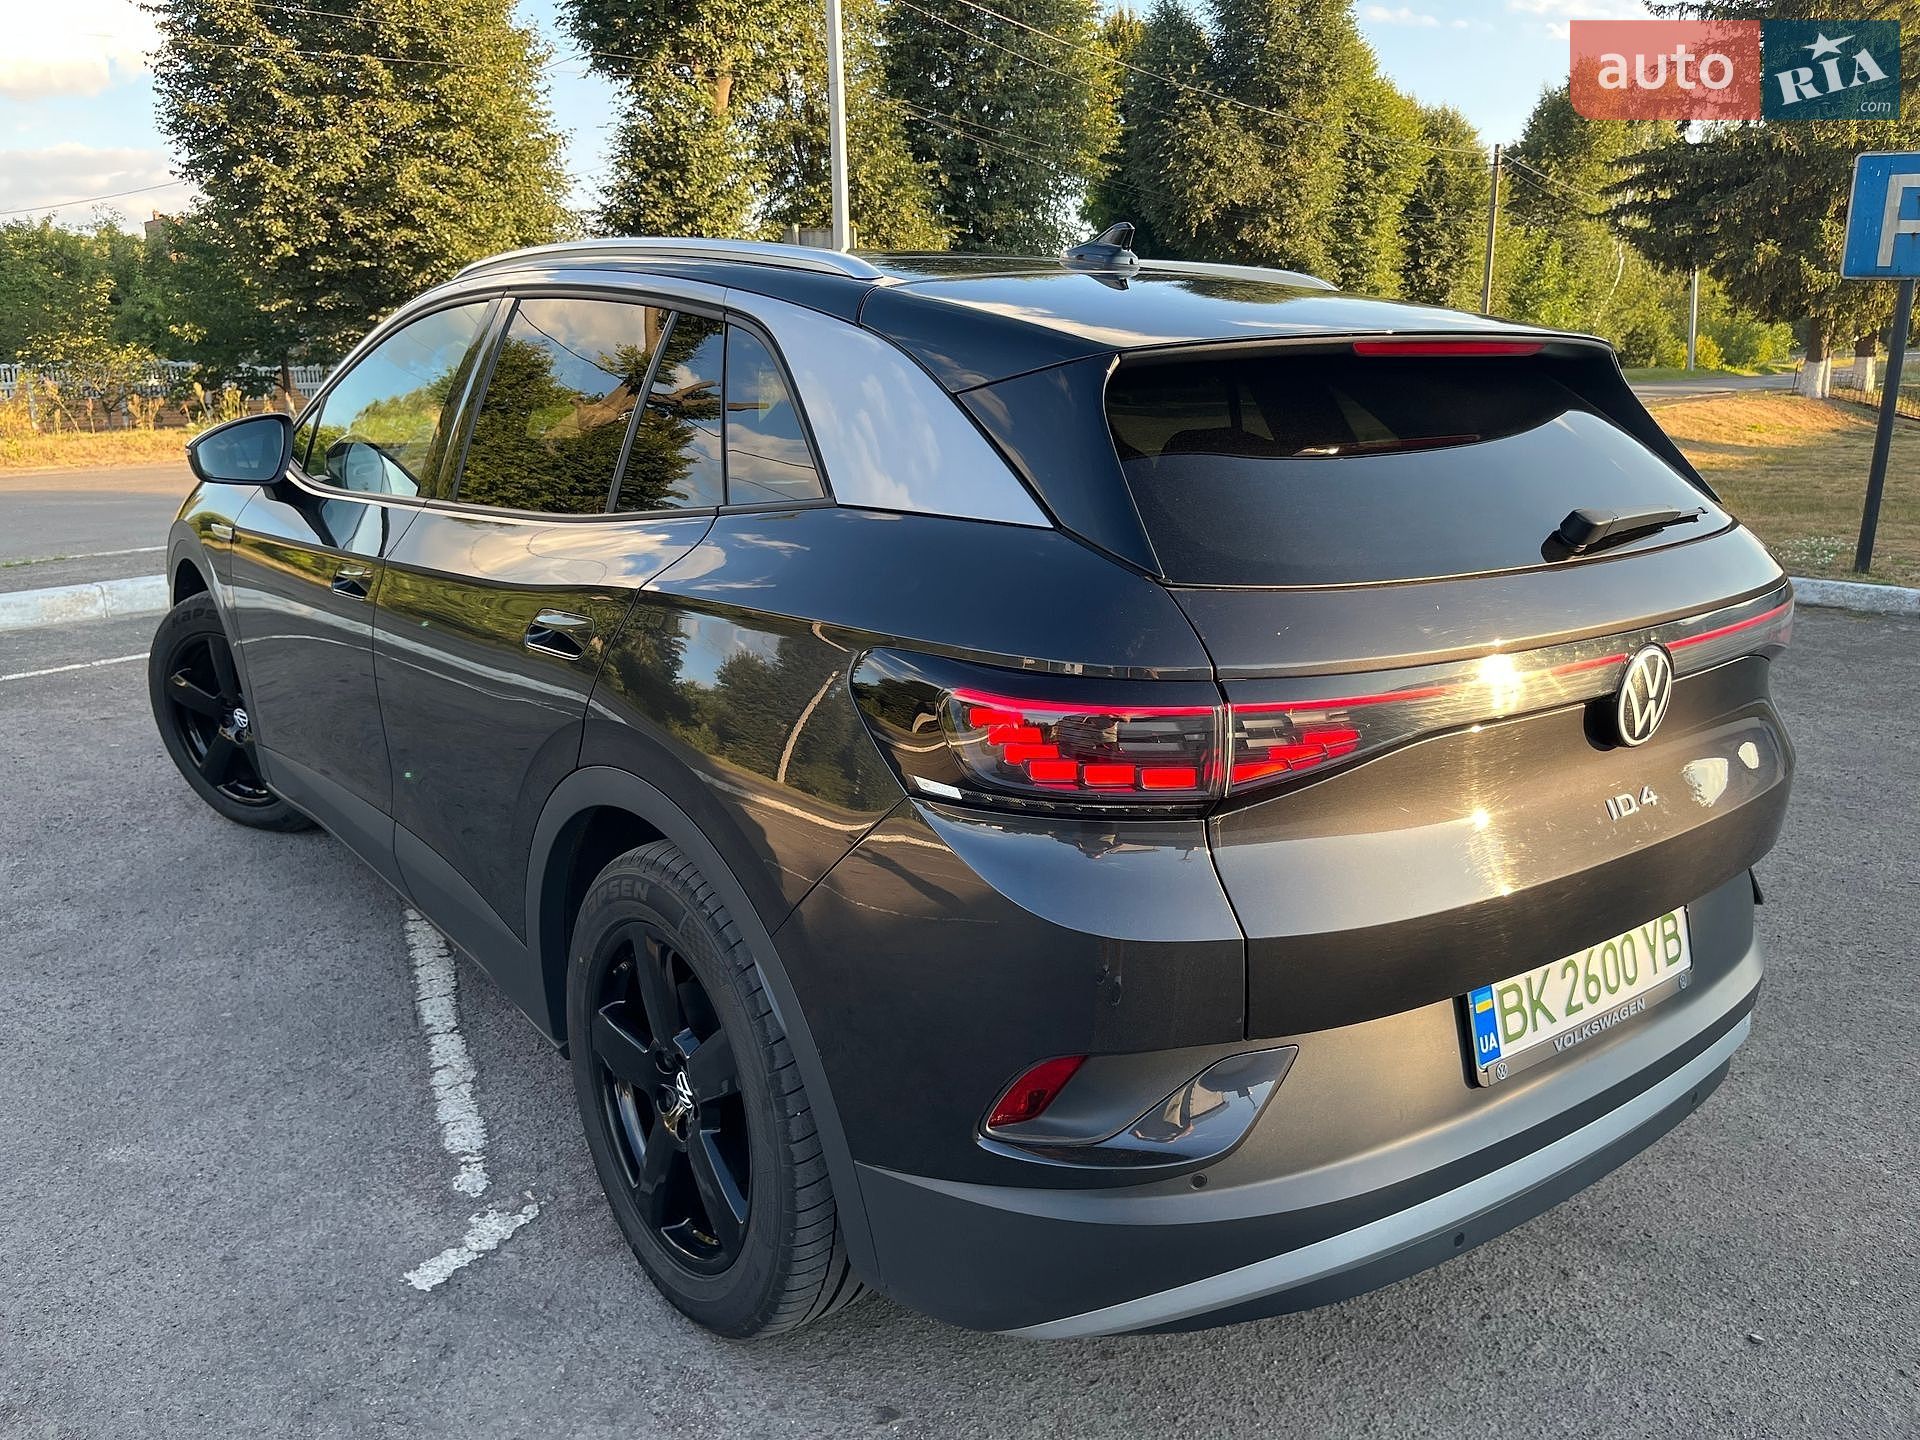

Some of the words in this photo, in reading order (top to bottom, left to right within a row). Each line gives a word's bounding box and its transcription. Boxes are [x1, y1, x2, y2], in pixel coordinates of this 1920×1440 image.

[1605, 785, 1658, 821] ID.4
[1497, 968, 1557, 1044] BK
[1561, 933, 1639, 1017] 2600
[1641, 912, 1682, 976] YB
[1480, 1031, 1499, 1054] UA
[1553, 998, 1647, 1053] VOLKSWAGEN
